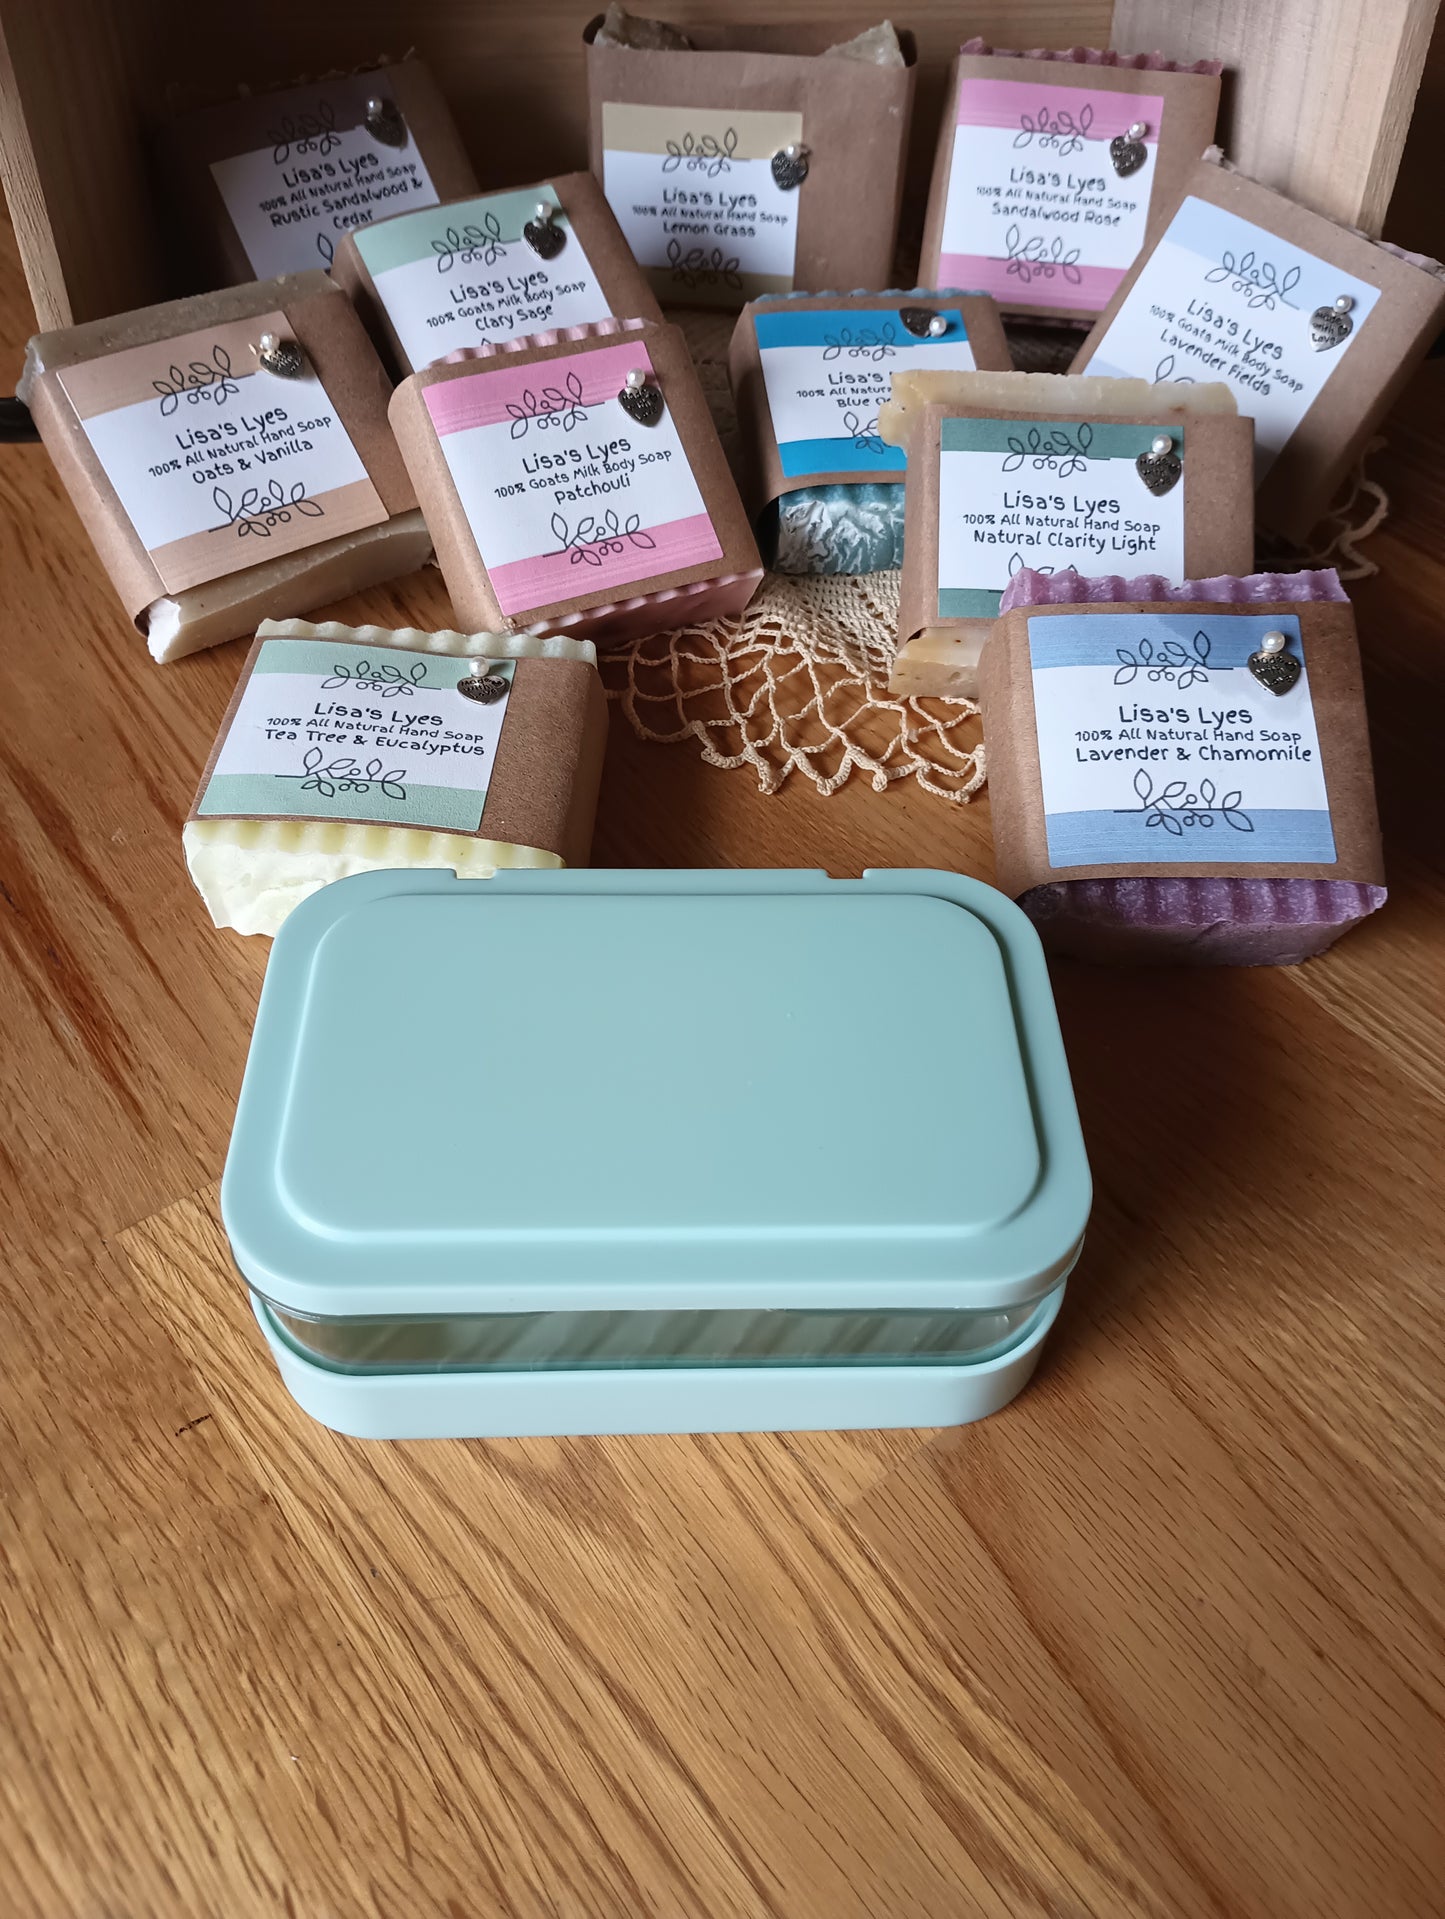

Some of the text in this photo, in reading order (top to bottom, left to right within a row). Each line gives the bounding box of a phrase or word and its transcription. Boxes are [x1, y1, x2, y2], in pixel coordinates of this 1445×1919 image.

[282, 152, 379, 189] Lisa's Lyes
[291, 190, 308, 205] All
[310, 177, 353, 197] Natural
[355, 170, 385, 187] Hand
[386, 163, 416, 177] Soap
[1009, 165, 1106, 195] Lisa's Lyes
[270, 177, 423, 227] Rustic Sandalwood &
[663, 186, 757, 211] Lisa's Lyes
[1005, 188, 1021, 198] All
[1025, 190, 1069, 204] Natural
[1073, 194, 1103, 207] Hand
[1107, 198, 1137, 213] Soap
[333, 210, 373, 229] Cedar
[661, 206, 677, 217] All
[680, 209, 723, 220] Natural
[726, 211, 756, 222] Hand
[759, 212, 789, 227] Soap
[991, 201, 1121, 228] Sandalwood Rose
[663, 221, 756, 238] Lemon Grass
[450, 271, 549, 304] Lisa's Lyes
[426, 280, 586, 328] 100% Goats Milk Body Soap
[475, 304, 553, 331] Clary Sage
[1187, 298, 1283, 360] Lisa's Lyes
[1160, 328, 1272, 396] Lavender Fields
[1177, 318, 1212, 343] Goats
[1214, 337, 1240, 357] Milk
[1241, 351, 1271, 377] Body
[1273, 368, 1304, 394] Soap
[828, 372, 884, 385] Lisa's
[796, 390, 825, 398] 100%
[829, 388, 847, 396] All
[837, 398, 870, 408] Blue
[175, 407, 288, 450] Lisa's Lyes
[149, 416, 332, 477] 100% All Natural Hand Soap
[522, 438, 631, 474] Lisa's Lyes
[192, 438, 314, 484] Oats & Vanilla
[494, 450, 672, 498] 100% Goats Milk Body Soap
[1004, 490, 1121, 518] Lisa's Lyes
[963, 513, 1161, 535] 100% All Natural Hand Soap
[974, 529, 1156, 555] Natural Clarity Light
[314, 702, 444, 727] Lisa's Lyes
[1119, 704, 1253, 730] Lisa's Lyes
[265, 729, 485, 756] Tea Tree & Eucalyptus
[267, 718, 484, 742] 100% All Natural Hand Soap
[1074, 728, 1302, 745] 100% All Natural Hand Soap
[1076, 745, 1312, 762] Lavender & Chamomile
